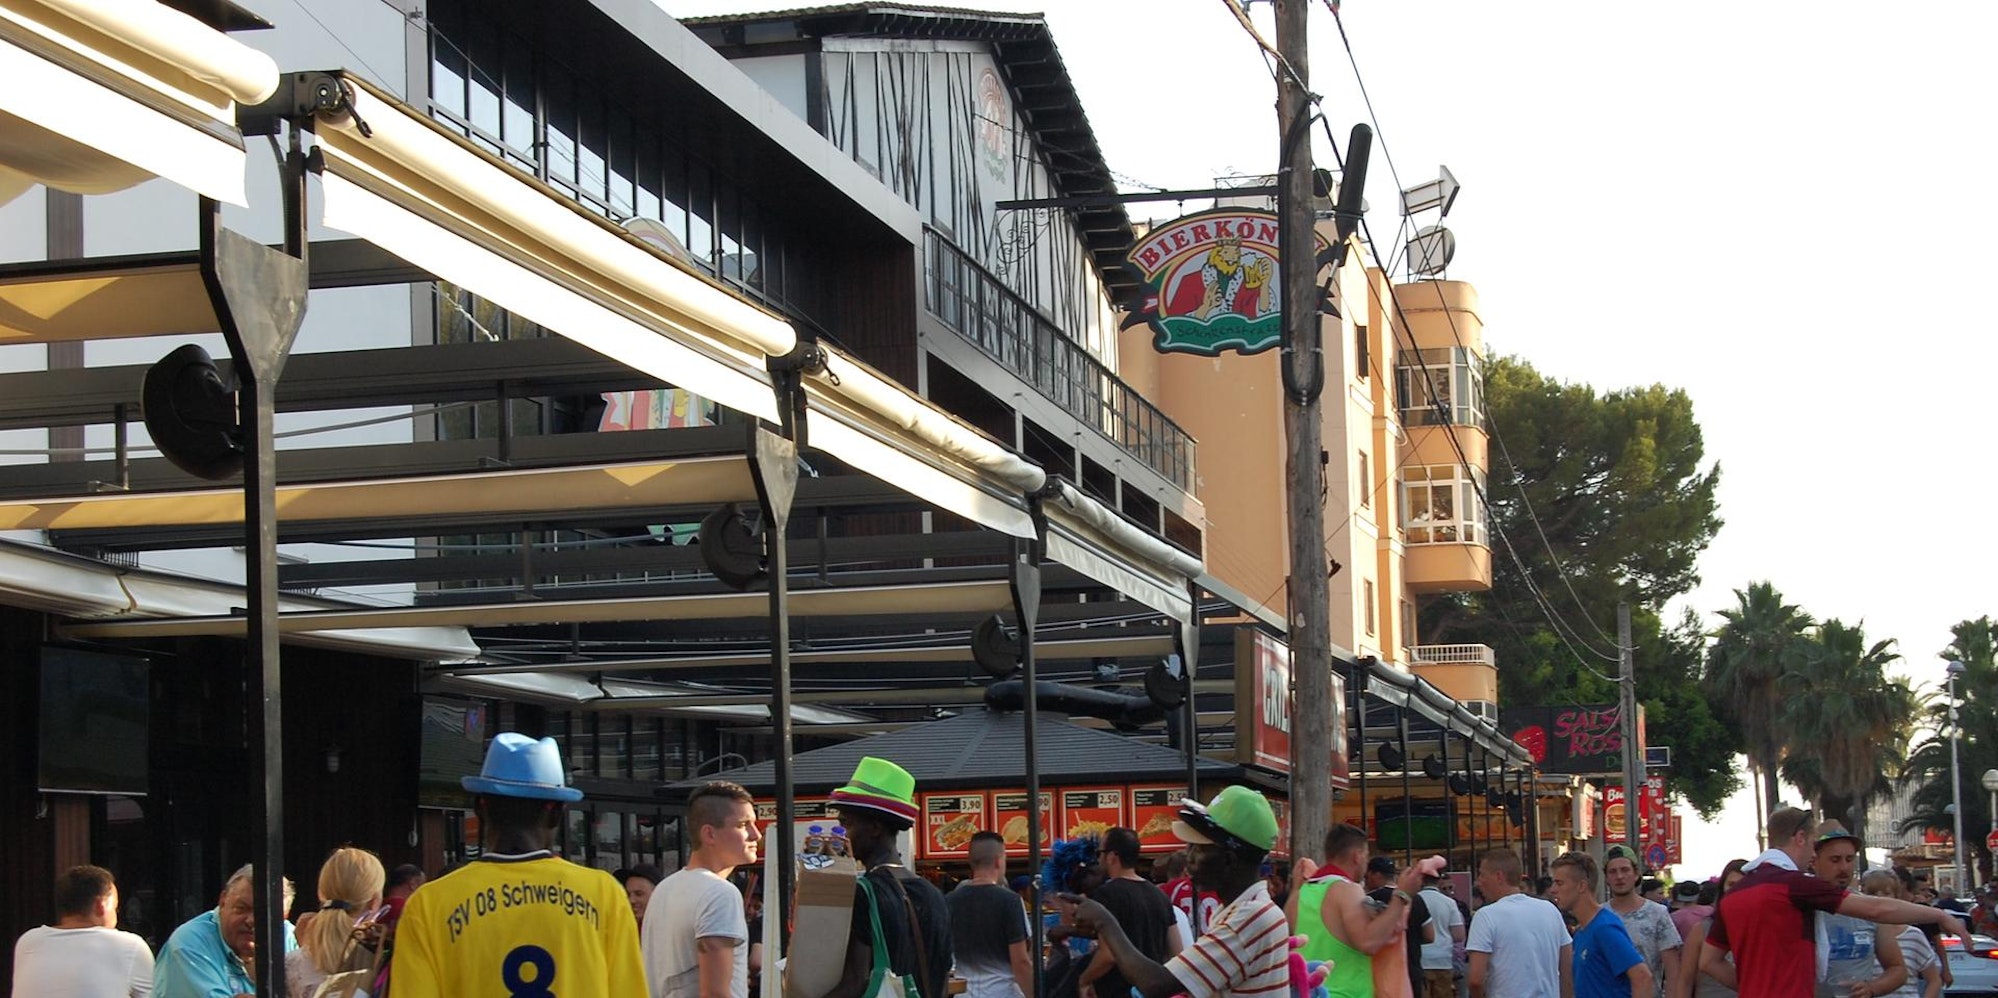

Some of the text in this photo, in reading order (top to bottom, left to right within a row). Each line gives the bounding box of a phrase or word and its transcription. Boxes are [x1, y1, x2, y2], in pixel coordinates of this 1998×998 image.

[1140, 217, 1279, 268] BIERKÖN
[1262, 663, 1289, 734] GRIL
[1553, 708, 1621, 738] SALS
[1568, 731, 1622, 758] ROS
[1647, 778, 1662, 788] OS
[962, 800, 981, 811] 3,90
[447, 881, 599, 943] TSV 08 Schweigern
